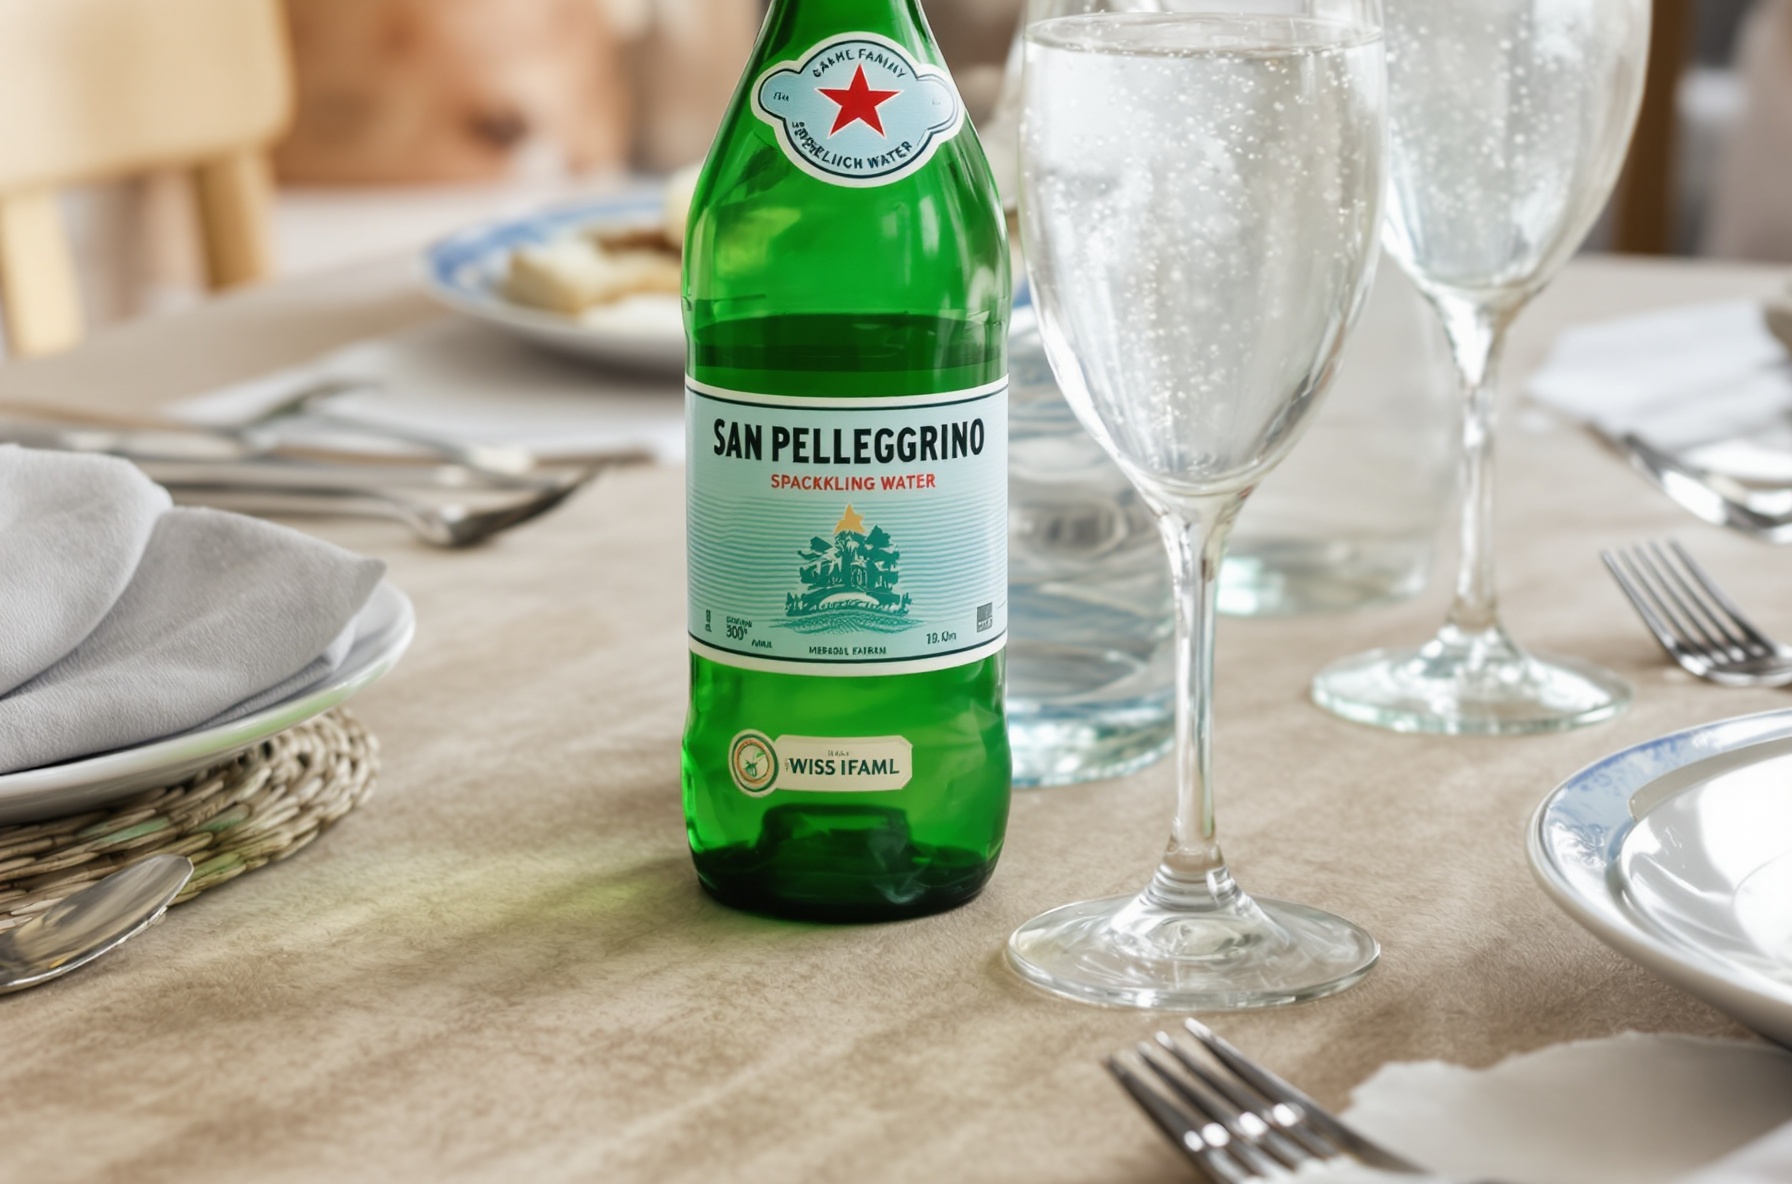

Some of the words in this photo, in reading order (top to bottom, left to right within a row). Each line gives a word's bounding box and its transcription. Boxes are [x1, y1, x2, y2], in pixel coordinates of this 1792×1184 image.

[867, 141, 913, 169] WATER
[713, 418, 763, 461] SAN
[771, 418, 985, 464] PELLEGGRINO
[771, 474, 876, 491] SPACKKLING
[881, 473, 936, 490] WATER
[789, 758, 836, 776] WISS
